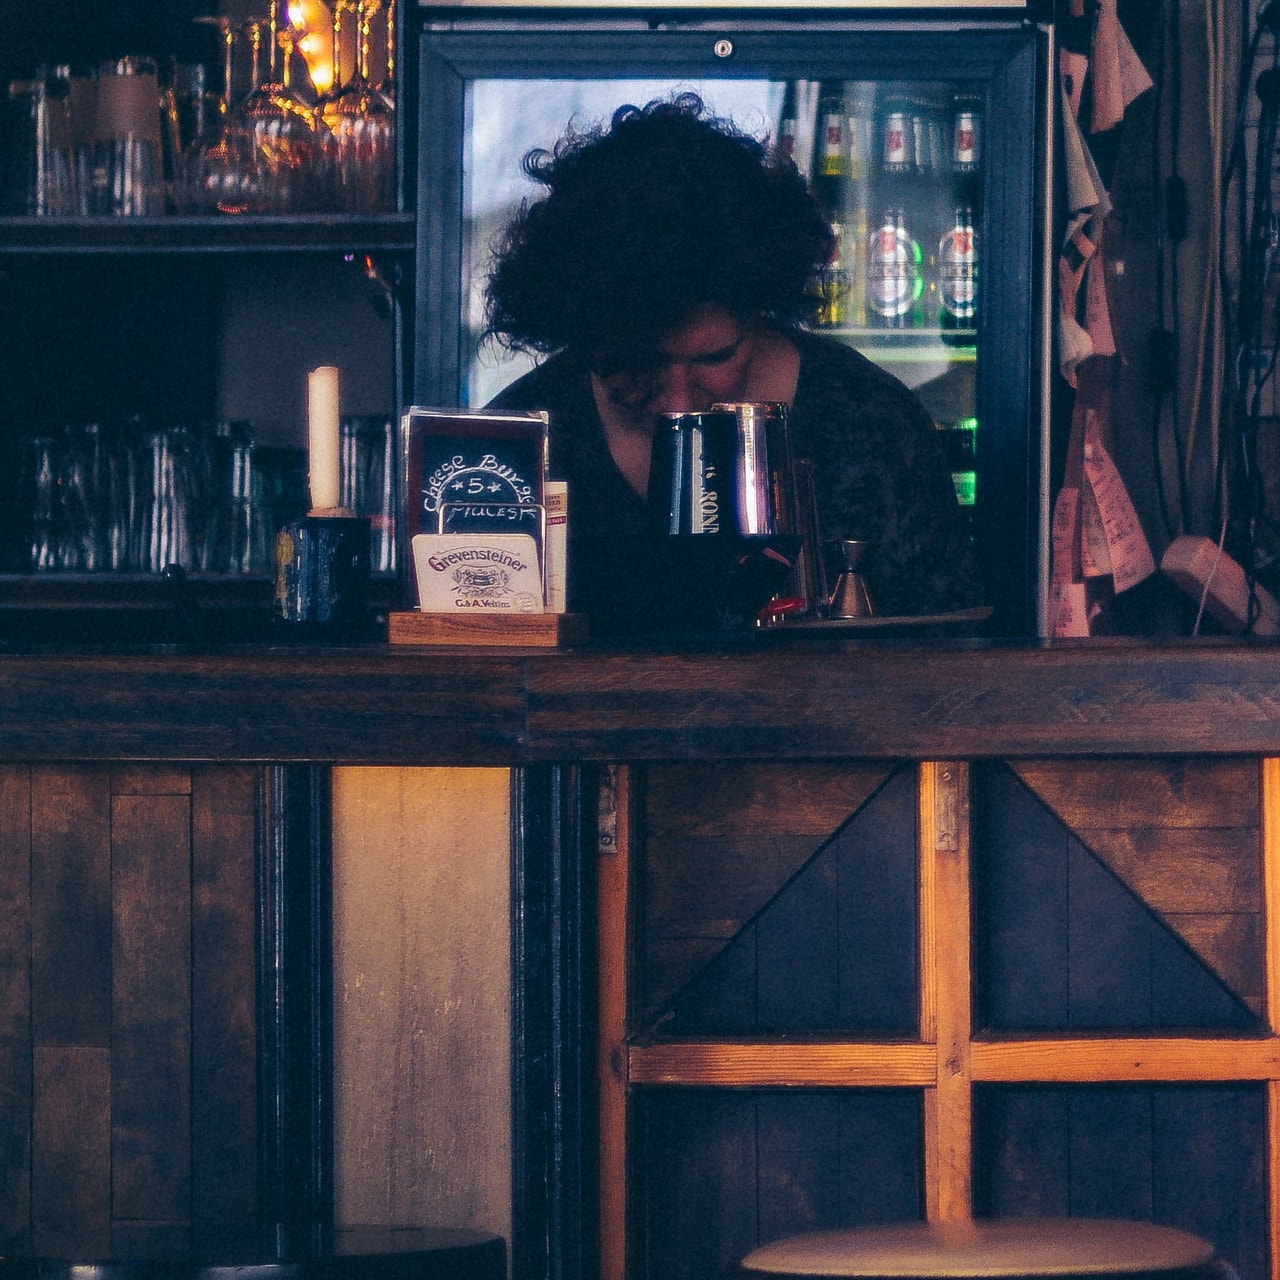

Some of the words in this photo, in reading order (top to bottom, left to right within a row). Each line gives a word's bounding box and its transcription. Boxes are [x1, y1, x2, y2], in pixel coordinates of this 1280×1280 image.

[424, 455, 464, 512] Cheese
[467, 477, 483, 495] 5
[428, 548, 527, 572] Grevensteiner
